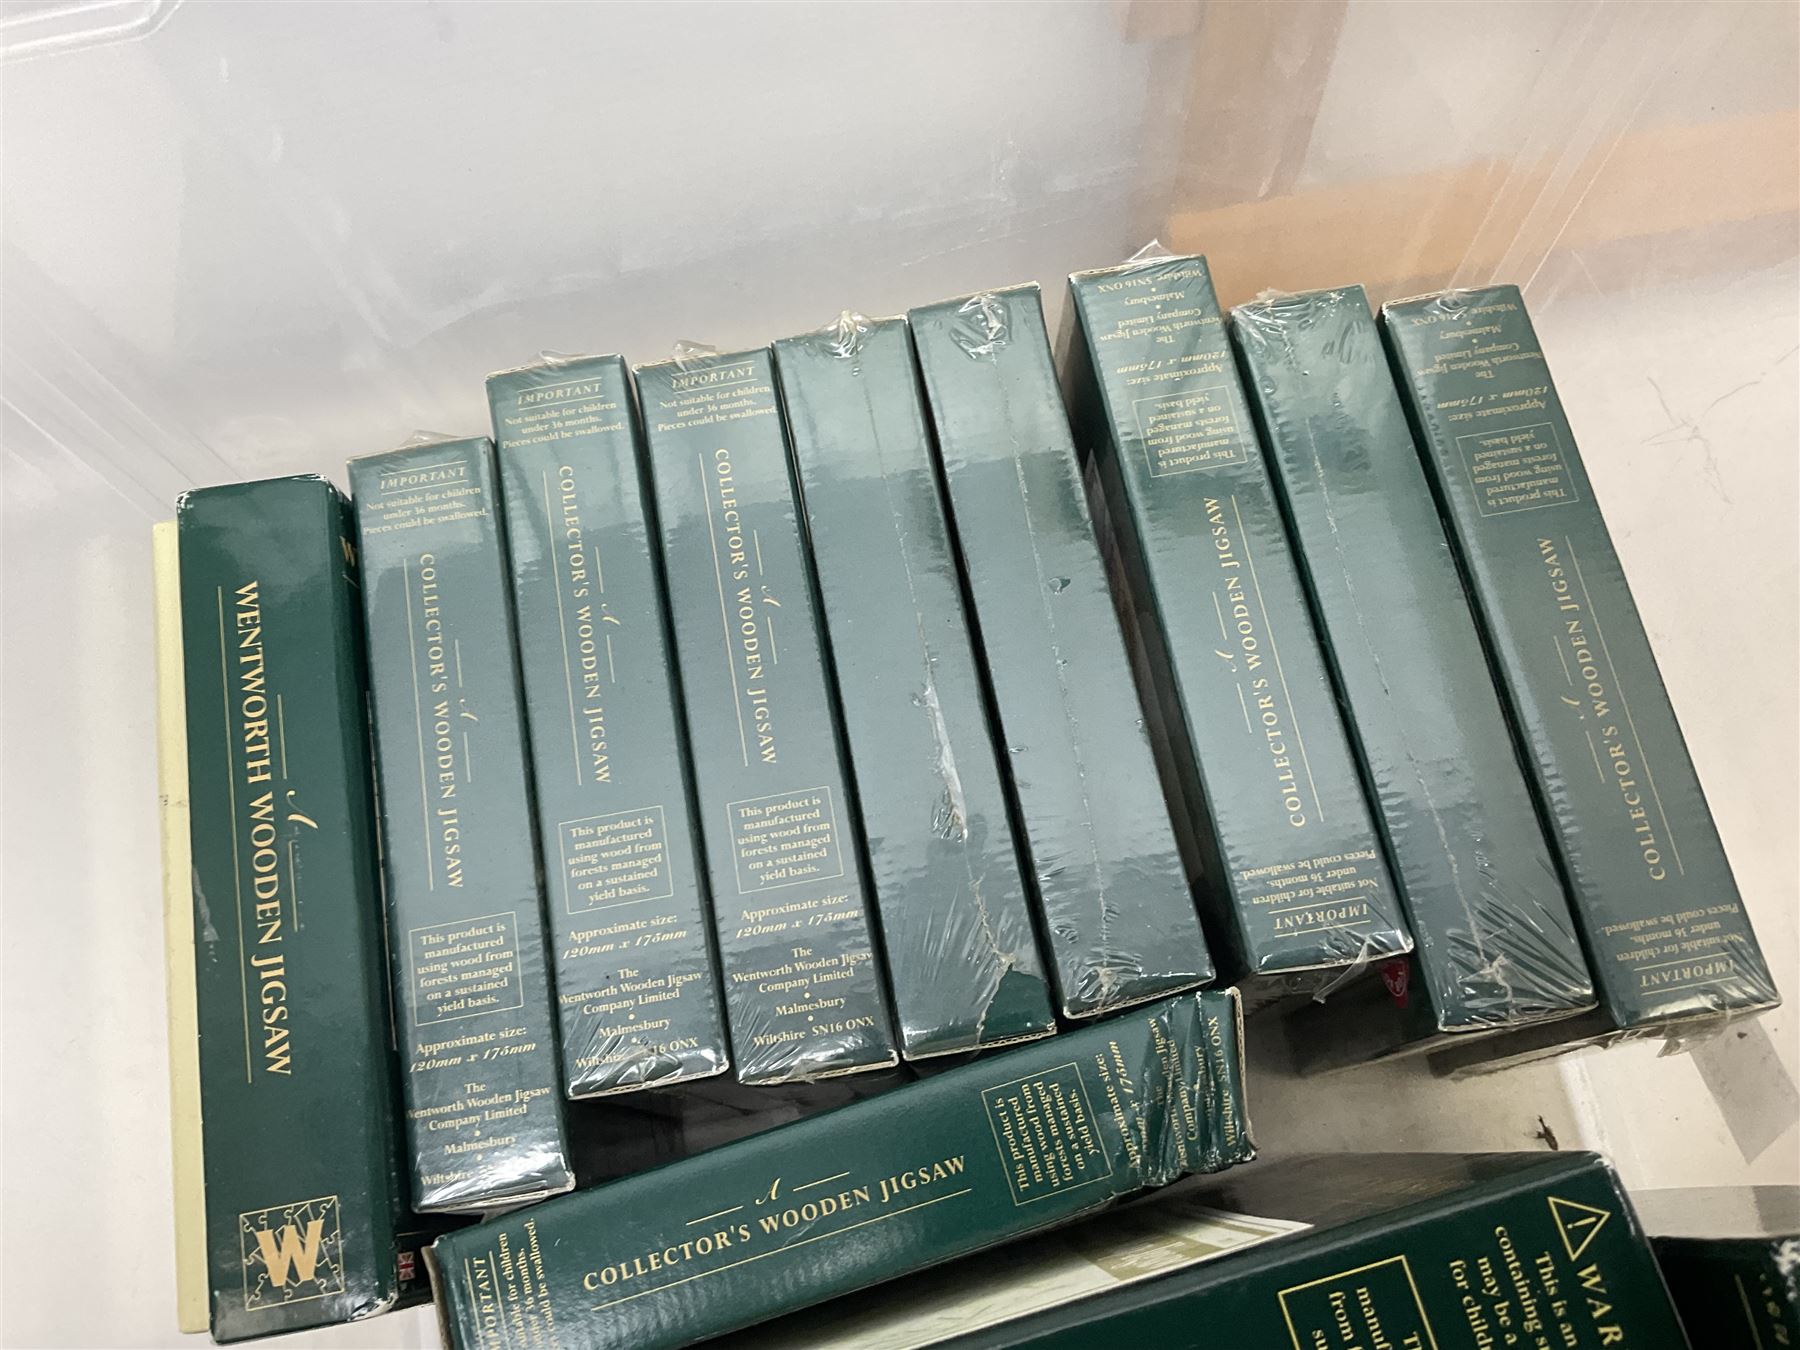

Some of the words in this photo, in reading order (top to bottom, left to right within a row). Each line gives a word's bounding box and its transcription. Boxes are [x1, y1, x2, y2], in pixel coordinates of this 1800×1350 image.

[379, 466, 467, 490] IMPORTANT
[713, 447, 750, 580] COLLECTOR'S
[557, 464, 590, 597] COLLECTOR'S
[1202, 494, 1240, 570] JIGSAW
[1535, 536, 1579, 613] JIGSAW
[418, 552, 447, 693] COLLECTOR'S
[735, 587, 765, 679] WOODEN
[1223, 576, 1264, 670] WOODEN
[574, 604, 601, 698] WOODEN
[234, 580, 272, 784] WENTWORTH
[1563, 619, 1612, 717] WOODEN
[746, 686, 777, 765] JIGSAW
[431, 700, 456, 799] WOODEN
[583, 705, 611, 785] JIGSAW
[1250, 677, 1308, 827] COLLECTOR'S
[737, 804, 762, 818] This
[763, 796, 810, 816] product
[810, 794, 821, 805] is
[1599, 724, 1668, 881] COLLECTOR'S
[569, 824, 594, 838] This
[595, 815, 642, 836] product
[643, 813, 654, 825] is
[736, 830, 767, 848] using
[768, 824, 801, 839] wood
[801, 819, 830, 834] from
[742, 807, 820, 831] manufactured
[437, 806, 463, 890] JIGSAW
[567, 849, 598, 868] using
[599, 843, 632, 859] wood
[633, 838, 662, 853] from
[573, 827, 652, 851] manufactured
[739, 841, 778, 858] forests
[779, 832, 831, 854] managed
[248, 790, 283, 944] WOODEN
[569, 861, 608, 878] forests
[609, 851, 662, 873] managed
[747, 860, 763, 870] on
[765, 858, 773, 867] a
[774, 846, 827, 865] sustained
[1238, 862, 1297, 882] swallowed.
[1296, 859, 1312, 872] be
[1311, 854, 1343, 870] could
[1343, 848, 1377, 865] Pieces
[576, 880, 593, 890] on
[595, 878, 602, 887] a
[604, 865, 658, 885] sustained
[758, 867, 787, 884] yield
[787, 861, 820, 876] basis.
[1265, 873, 1310, 891] months.
[1309, 871, 1323, 884] 36
[1325, 865, 1358, 881] under
[1356, 876, 1379, 890] Not
[586, 887, 616, 905] yield
[617, 881, 650, 897] basis.
[1250, 890, 1297, 908] children
[1297, 887, 1315, 900] for
[1314, 880, 1357, 897] suitable
[739, 897, 819, 923] Approximate
[820, 892, 849, 907] size:
[1271, 902, 1370, 930] IMPORTANT
[419, 932, 445, 946] This
[446, 923, 494, 944] product
[495, 921, 506, 933] is
[567, 917, 648, 945] Approximate
[649, 911, 677, 927] size:
[416, 958, 448, 977] using
[449, 952, 482, 968] wood
[484, 947, 513, 962] from
[423, 935, 504, 959] manufactured
[790, 944, 813, 958] The
[419, 971, 458, 988] forests
[459, 961, 513, 983] managed
[731, 962, 793, 983] Wentworth
[794, 954, 839, 972] Wooden
[758, 974, 810, 996] Company
[811, 966, 855, 984] Limited
[1636, 958, 1736, 988] IMPORTANT
[426, 991, 442, 1001] on
[444, 989, 451, 998] a
[453, 976, 509, 996] sustained
[436, 998, 465, 1016] yield
[466, 992, 499, 1008] basis.
[582, 995, 636, 1018] Company
[637, 987, 680, 1005] Limited
[250, 955, 291, 1076] JIGSAW
[774, 995, 848, 1019] Malmesbury
[414, 1029, 496, 1057] Approximate
[498, 1024, 527, 1039] size:
[597, 1014, 672, 1041] Malmesbury
[752, 1026, 806, 1046] Wiltshire
[811, 1020, 843, 1036] SN16
[1149, 1017, 1167, 1055] Jigsaw
[1095, 1053, 1111, 1082] size:
[1108, 1041, 1134, 1094] 175mm
[1215, 1049, 1227, 1082] SN16
[991, 1096, 1005, 1109] is
[1016, 1082, 1037, 1115] from
[1031, 1078, 1062, 1138] managed
[1047, 1081, 1076, 1141] sustained
[1064, 1087, 1086, 1124] basis.
[428, 1110, 481, 1133] Company
[483, 1102, 528, 1121] Limited
[1106, 1086, 1139, 1169] Approximate
[996, 1109, 1024, 1161] product
[1006, 1095, 1043, 1184] manufactured
[1027, 1115, 1048, 1152] wood
[1070, 1142, 1079, 1150] a
[1076, 1123, 1099, 1157] yield
[1039, 1152, 1063, 1188] using
[1049, 1138, 1073, 1182] forests
[1073, 1152, 1086, 1171] on
[1012, 1162, 1031, 1192] This
[580, 1220, 752, 1292] COLLECTOR'S
[757, 1184, 871, 1237] WOODEN
[877, 1154, 968, 1203] JIGSAW
[256, 1220, 324, 1288] W
[499, 1232, 515, 1281] children
[524, 1218, 545, 1280] swallowed.
[516, 1248, 533, 1295] months.
[1449, 1259, 1469, 1290] for
[1495, 1226, 1543, 1333] containing
[507, 1283, 519, 1301] for
[524, 1296, 535, 1313] 36
[537, 1282, 549, 1298] be
[1477, 1256, 1501, 1296] may
[1494, 1300, 1511, 1327] be
[1504, 1333, 1517, 1345] a
[1535, 1251, 1559, 1295] This
[1552, 1300, 1567, 1317] is
[1560, 1323, 1578, 1348] an
[1577, 1263, 1624, 1347] WAR
[539, 1300, 556, 1332] could
[1328, 1291, 1354, 1341] from
